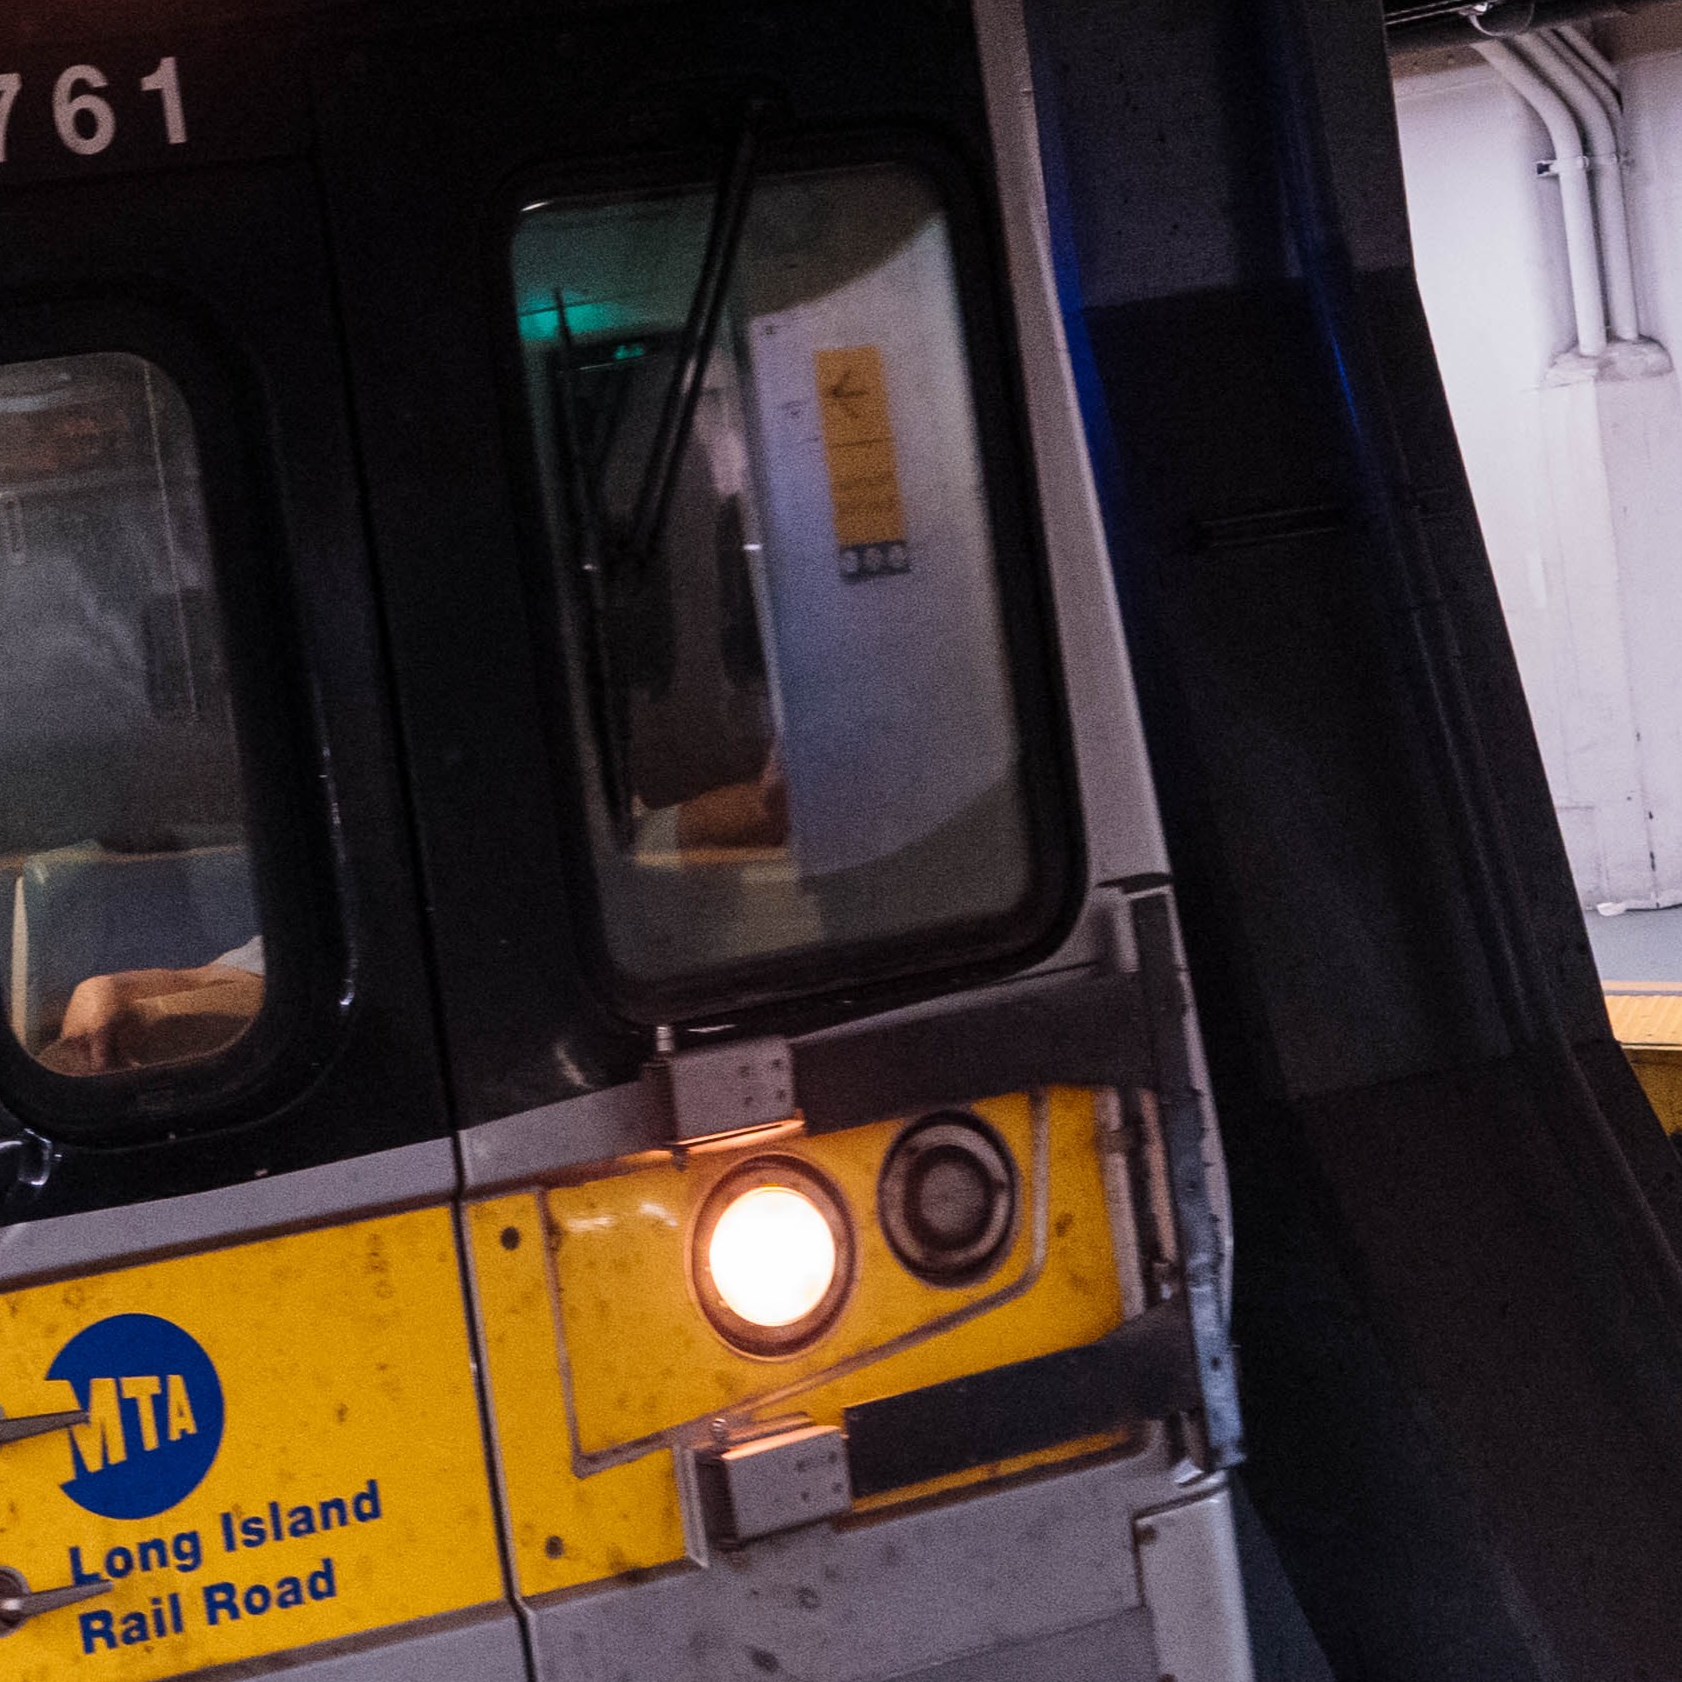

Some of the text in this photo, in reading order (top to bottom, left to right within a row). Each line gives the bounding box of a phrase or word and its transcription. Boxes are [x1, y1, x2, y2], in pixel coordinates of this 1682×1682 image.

[44, 1374, 197, 1480] MTA
[68, 1479, 383, 1588] Long Island
[78, 1558, 339, 1655] Rail Road
